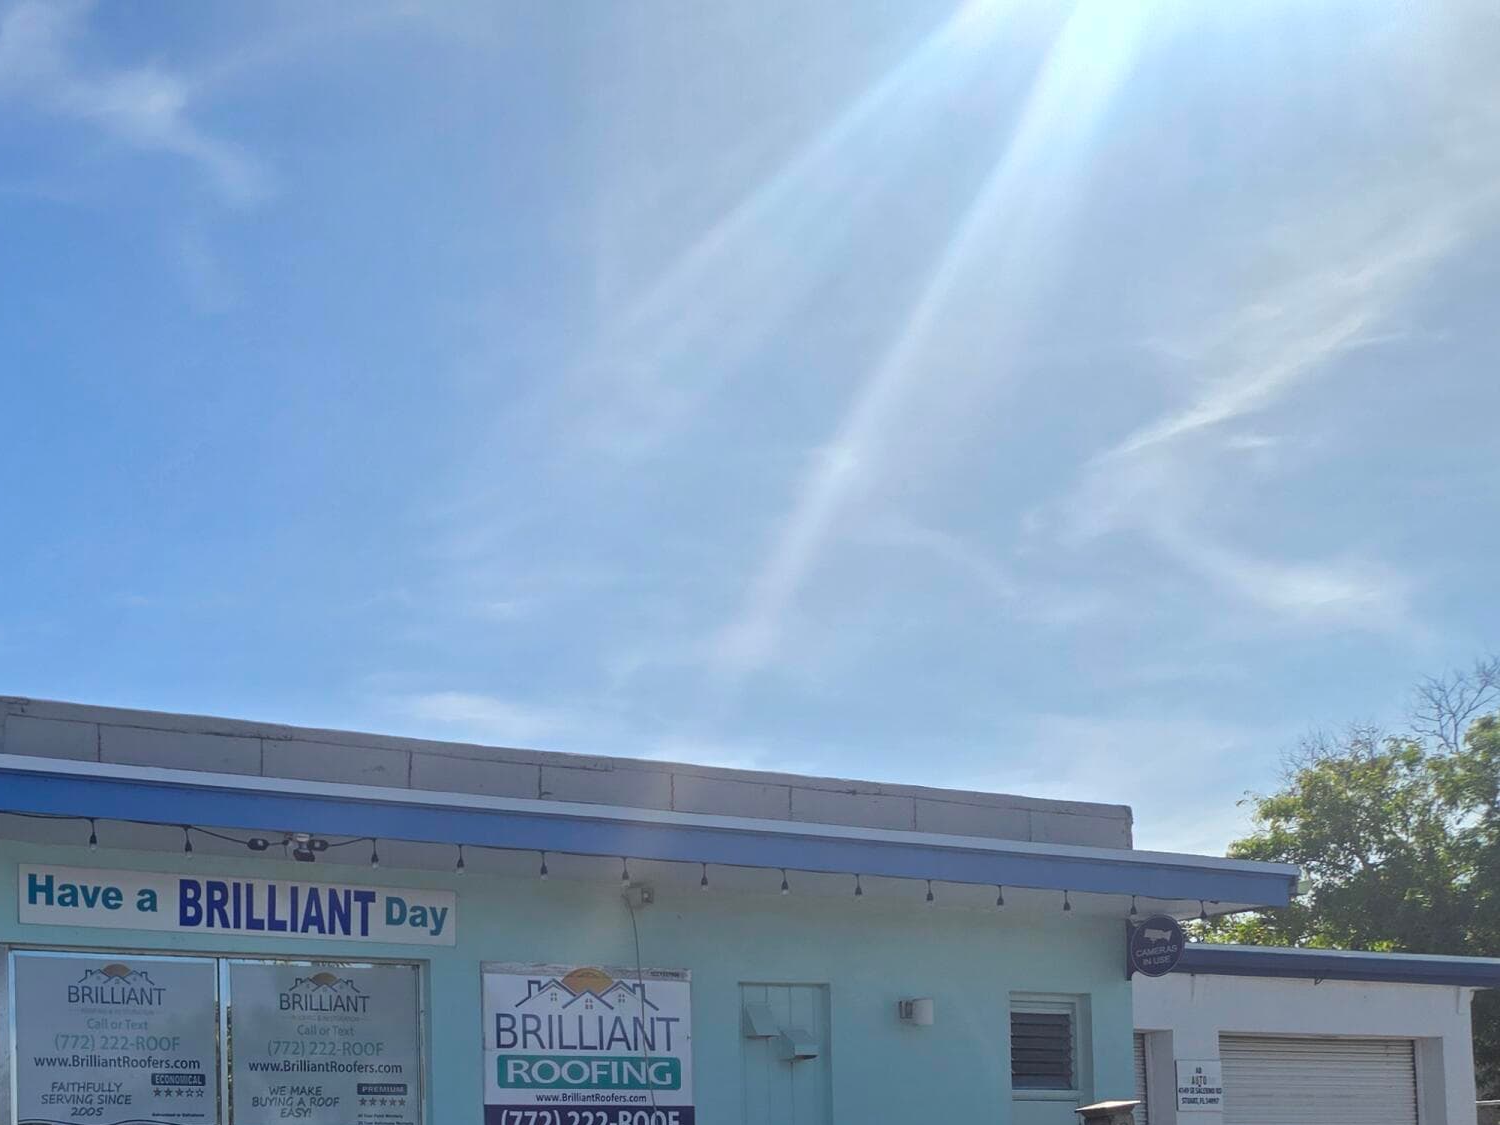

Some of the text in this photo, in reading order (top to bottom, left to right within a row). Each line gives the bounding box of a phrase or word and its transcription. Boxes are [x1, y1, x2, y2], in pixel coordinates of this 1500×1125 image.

[28, 873, 448, 937] Have a BRILLIANT Day
[68, 985, 166, 1005] BRILLIANT
[279, 993, 370, 1013] BRILLIANT
[86, 1018, 148, 1030] Call or Text
[297, 1024, 355, 1036] Call or Text
[495, 1013, 680, 1051] BRILLIANT
[54, 1034, 181, 1051] (772) 222-ROOF
[267, 1040, 385, 1056] (772) 222-ROOF
[33, 1054, 201, 1070] www.BrilliantRoofers.com
[248, 1060, 403, 1074] www.BrilliantRoofers.com
[507, 1059, 672, 1086] ROOFING
[51, 1081, 124, 1093] FAITHFULLY
[268, 1086, 322, 1096] WE MAKE
[40, 1094, 132, 1105] SERVING SINCE
[251, 1097, 340, 1108] BUYING A ROOF
[536, 1093, 647, 1103] www.BrilliantRoofers.com
[70, 1107, 104, 1117] 2005
[280, 1108, 312, 1118] EASY!
